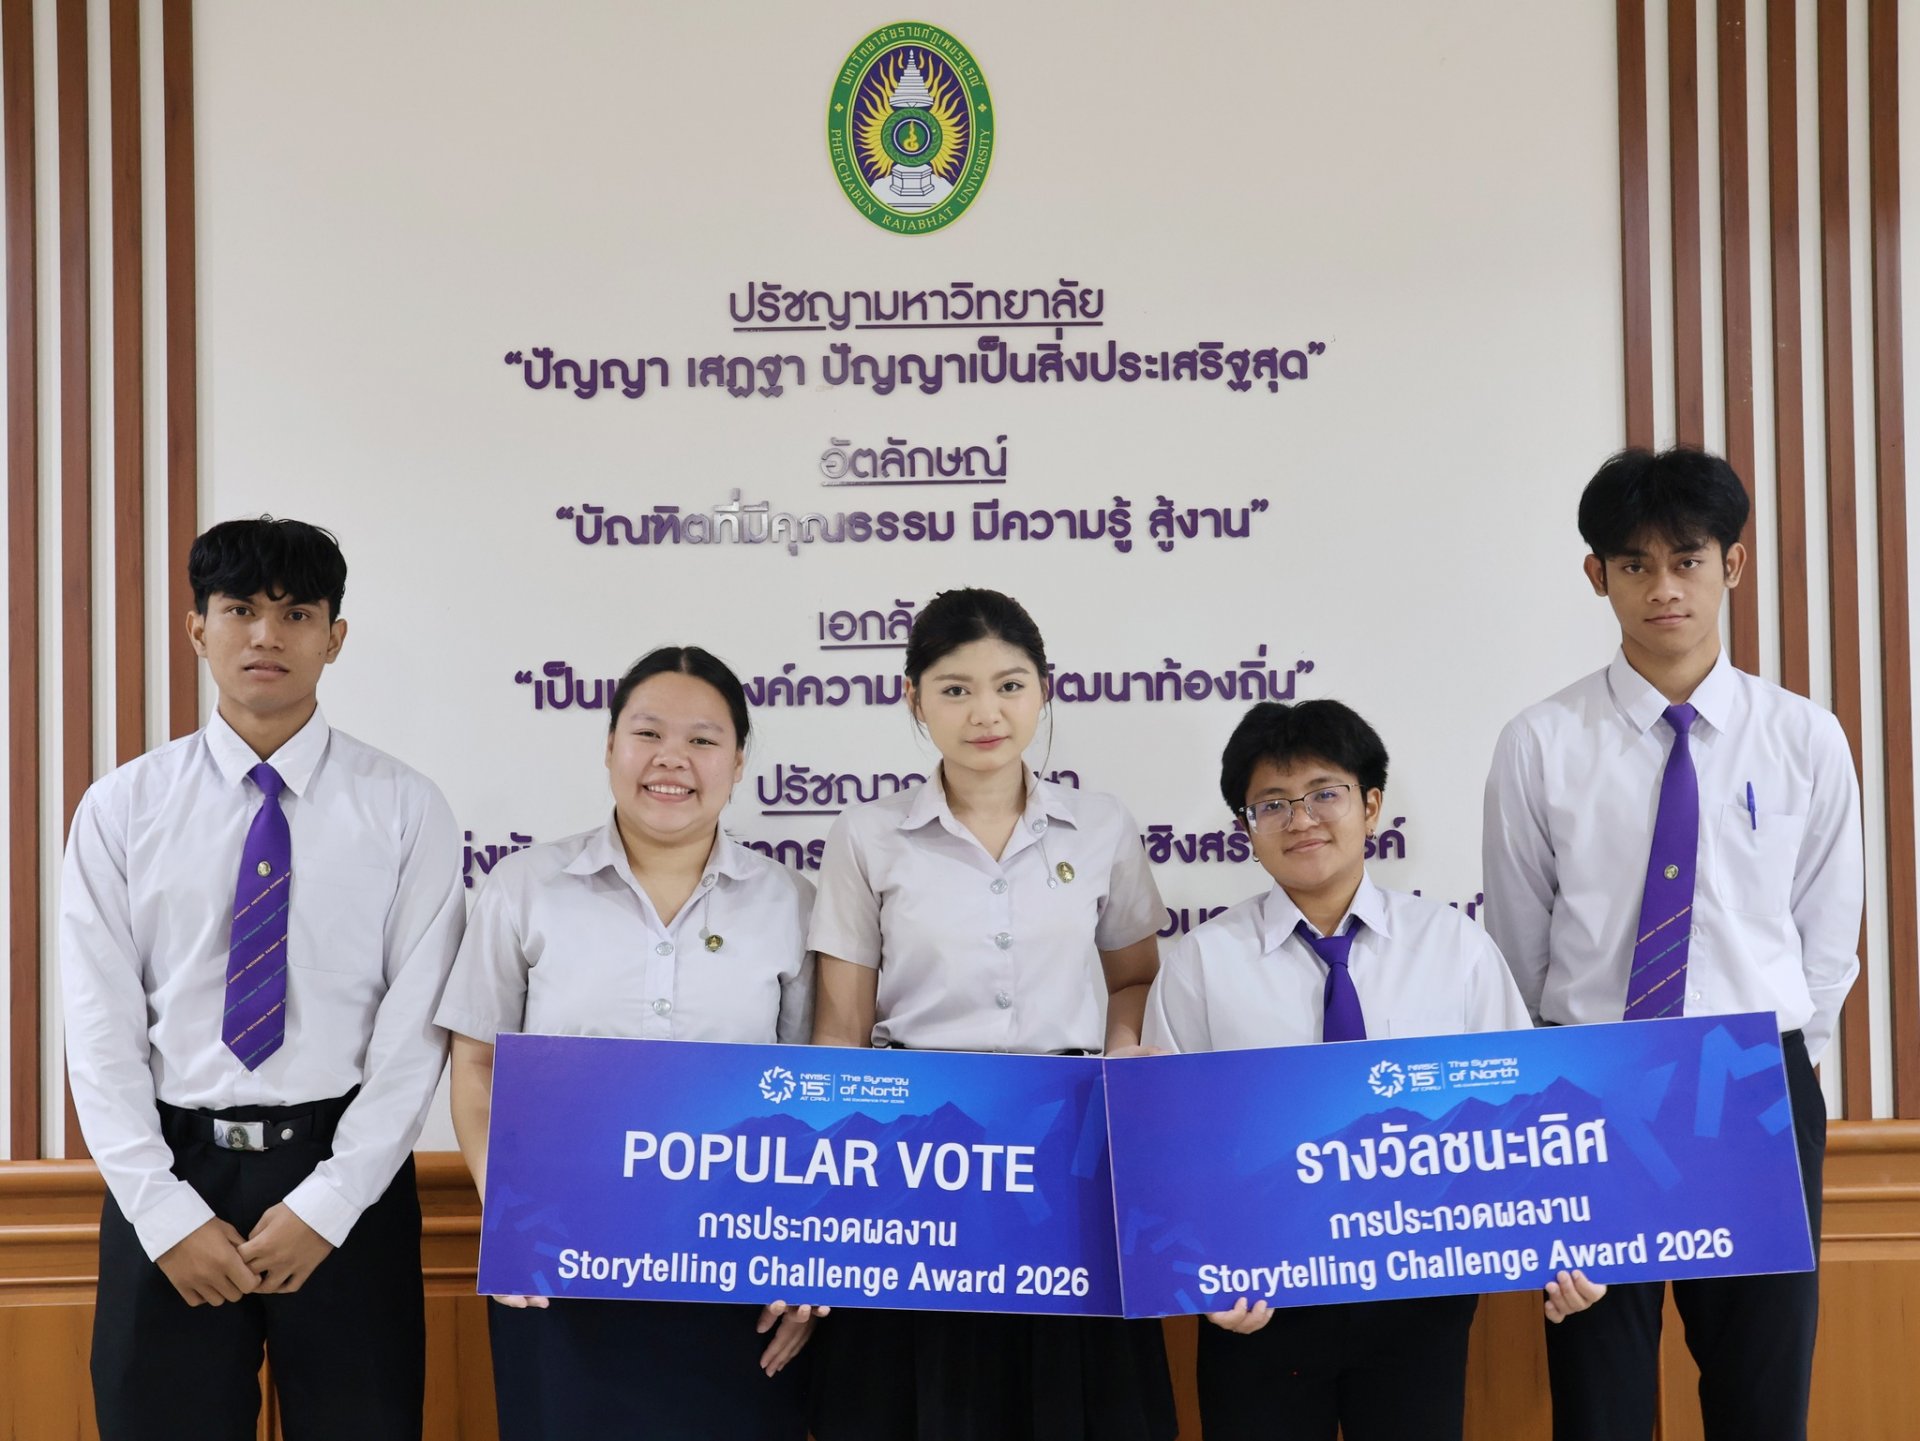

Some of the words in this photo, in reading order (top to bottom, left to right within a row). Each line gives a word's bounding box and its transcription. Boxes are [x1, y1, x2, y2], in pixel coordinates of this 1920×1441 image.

[831, 128, 877, 216] PHETCHABUN
[881, 206, 954, 231] RAJABHAT
[956, 128, 991, 205] UNIVERSITY
[729, 278, 1103, 331] ปรัชญามหาวิทยาลัย
[687, 354, 805, 398] เสฏฐา
[820, 435, 1007, 479] อัตลักษณ์
[973, 496, 1132, 553] มีความรู้
[819, 599, 921, 642] เอกลั
[840, 1074, 861, 1082] The
[863, 1075, 909, 1085] Synergy
[1448, 1060, 1469, 1069] The
[1449, 1070, 1468, 1082] of
[1470, 1067, 1519, 1080] North
[839, 1083, 858, 1095] of
[861, 1086, 909, 1097] North
[623, 1130, 879, 1188] POPULAR
[896, 1141, 1036, 1193] VOTE
[1296, 1113, 1608, 1185] รางวัลชนะเลิศ
[698, 1206, 957, 1247] การประกวดผลงาน
[1329, 1196, 1591, 1239] การประกวดผลงาน
[558, 1248, 737, 1292] Storytelling
[748, 1255, 899, 1297] Challenge
[908, 1259, 1005, 1295] Award
[1016, 1265, 1090, 1297] 2026
[1198, 1255, 1377, 1298] Storytelling
[1386, 1246, 1539, 1287] Challenge
[1548, 1233, 1648, 1270] Award
[1656, 1227, 1733, 1262] 2026
